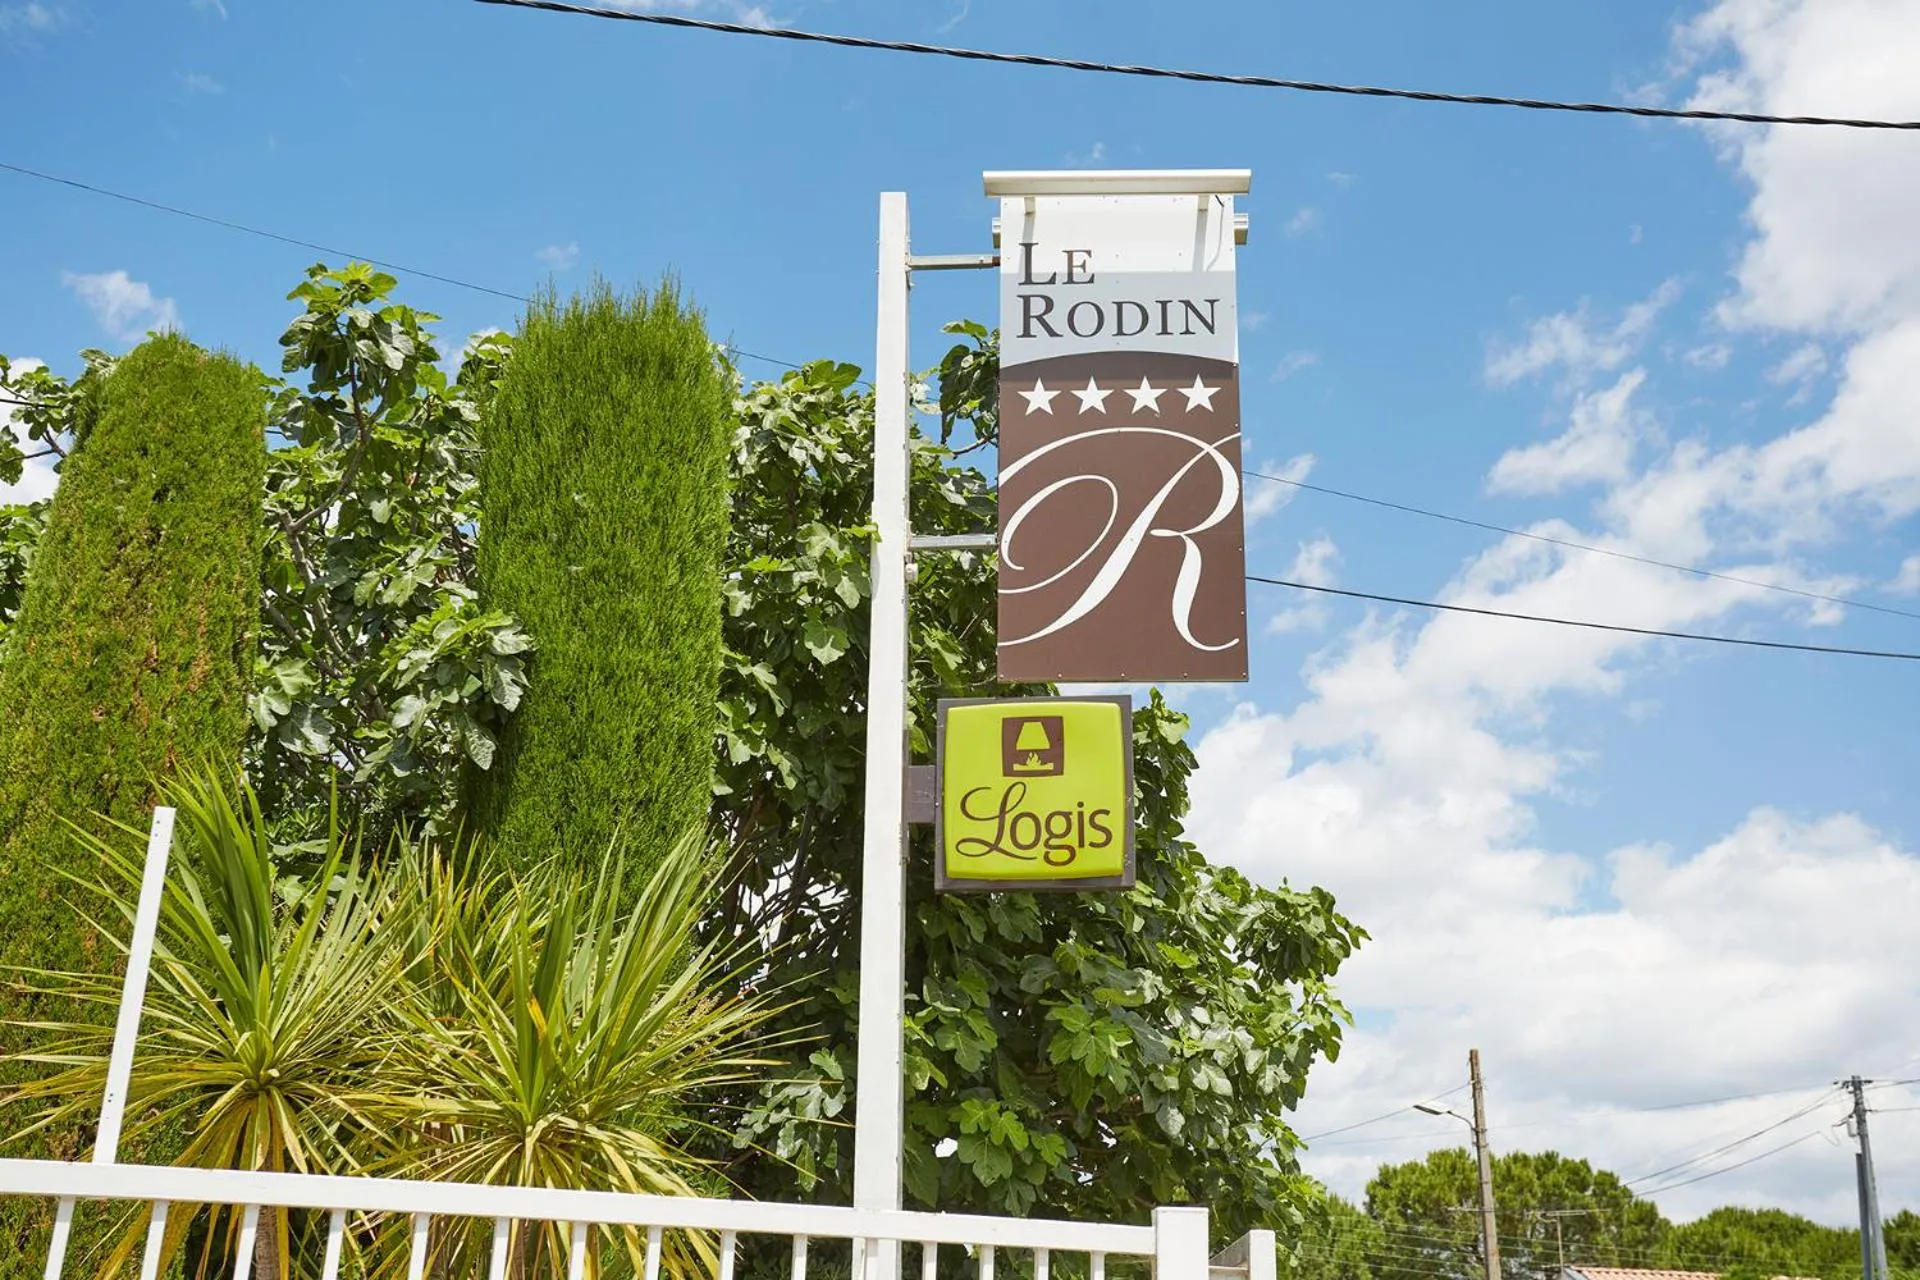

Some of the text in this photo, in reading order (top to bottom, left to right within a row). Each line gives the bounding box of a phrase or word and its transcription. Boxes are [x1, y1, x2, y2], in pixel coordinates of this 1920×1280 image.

[1018, 242, 1095, 285] LE
[1016, 294, 1220, 338] RODIN
[997, 426, 1242, 651] R
[955, 781, 1113, 867] Logis
